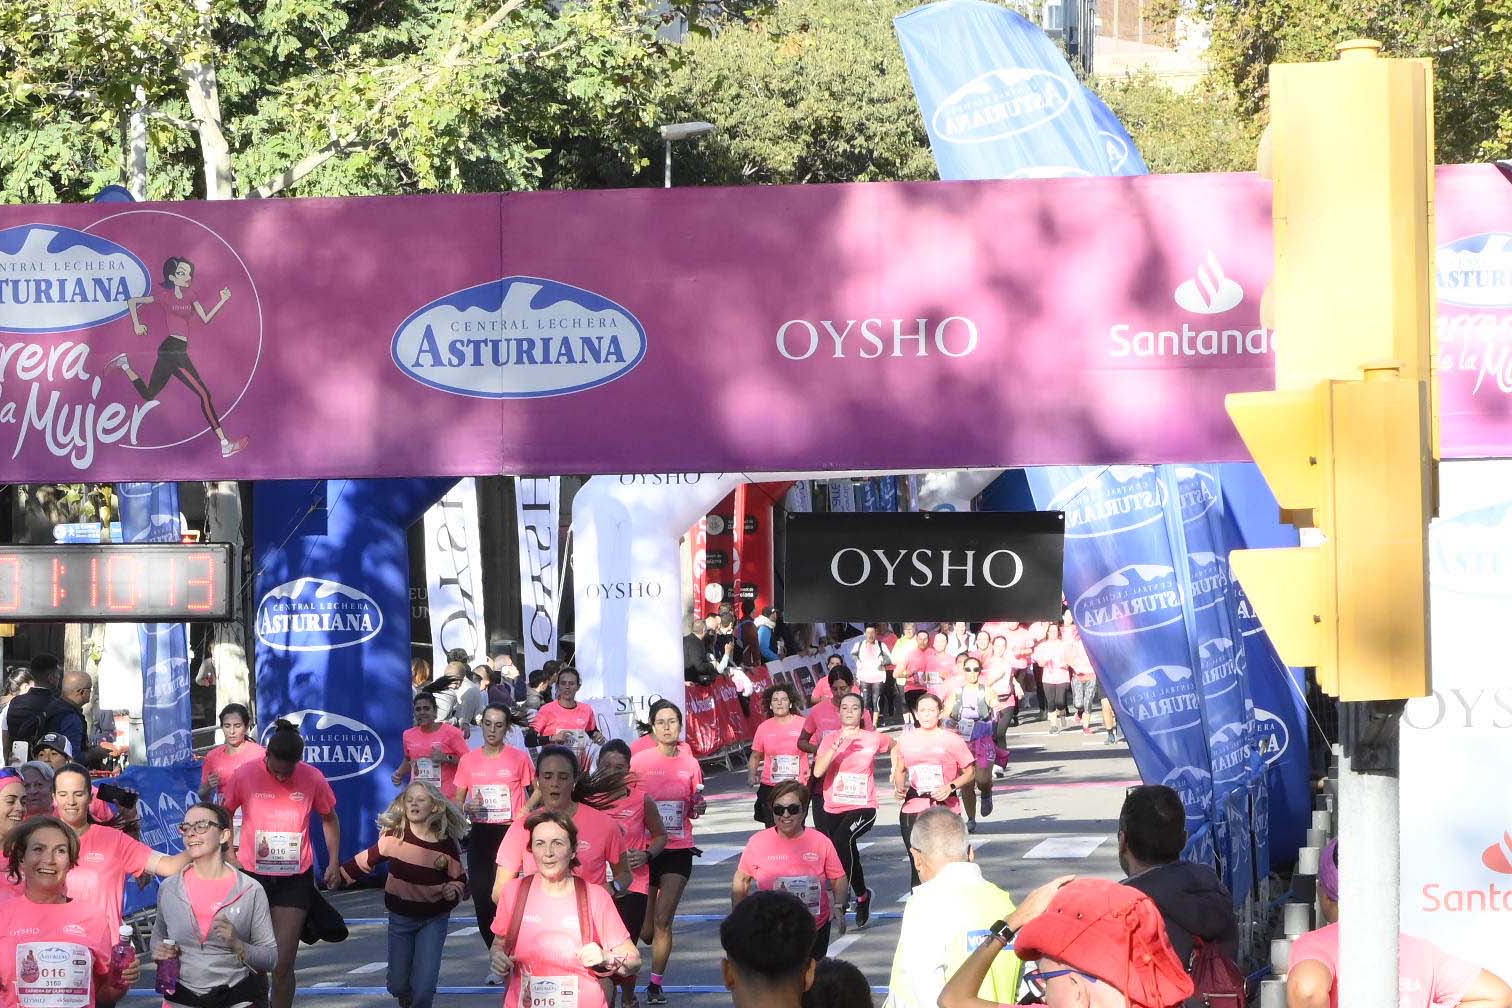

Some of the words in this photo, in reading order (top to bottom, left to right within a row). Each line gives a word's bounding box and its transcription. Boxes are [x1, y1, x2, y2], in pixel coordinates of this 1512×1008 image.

[53, 259, 125, 271] LECHERA
[450, 319, 529, 332] CENTRAL
[537, 317, 618, 329] LECHERA
[411, 324, 626, 368] ASTURIANA
[775, 316, 978, 360] OYSHO
[1110, 323, 1279, 356] Santand
[11, 375, 161, 470] Mujer
[830, 546, 1024, 588] OYSHO
[586, 582, 662, 601] OYSHO
[273, 602, 316, 612] CENTRAL
[319, 602, 369, 611] LECHERA
[260, 607, 374, 635] ASTURIANA
[320, 734, 370, 742] LECHERA
[41, 968, 66, 978] 016
[533, 998, 556, 1007] 016
